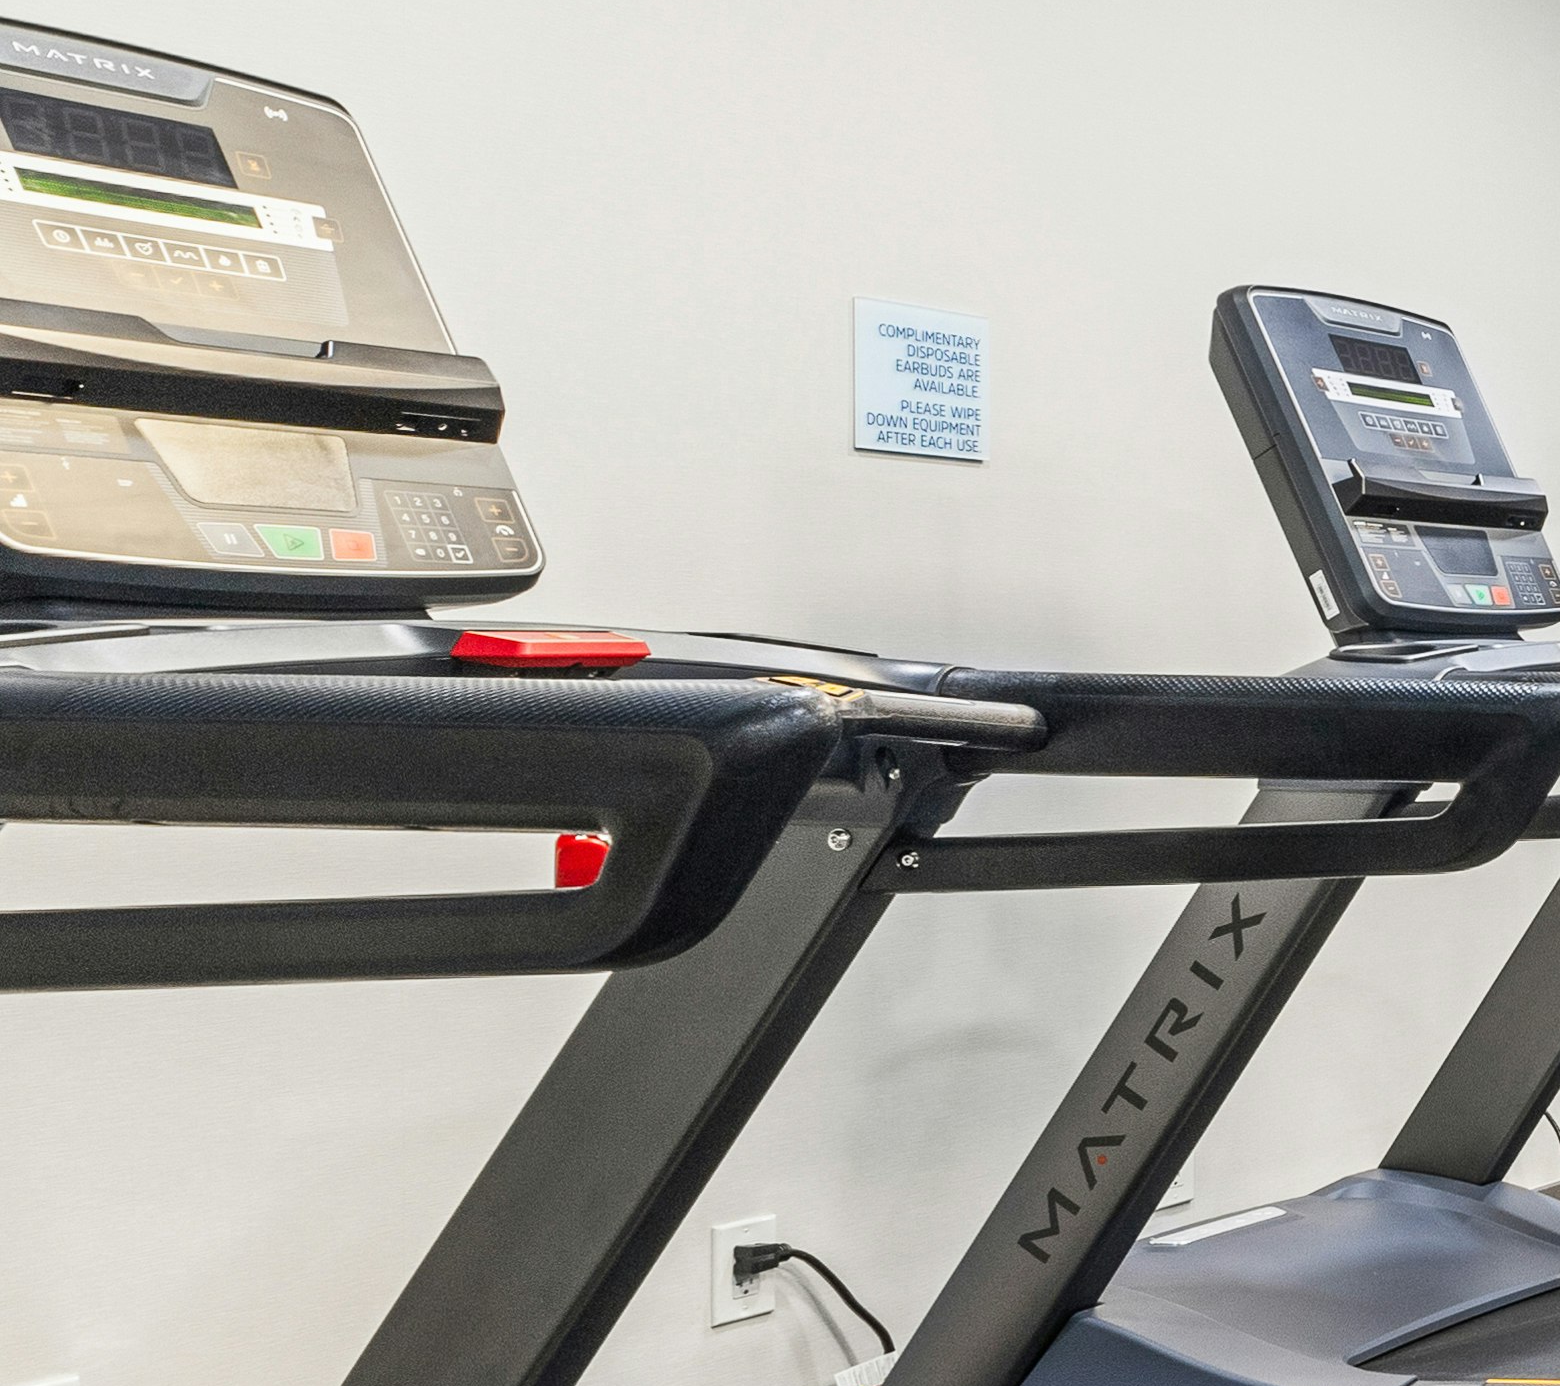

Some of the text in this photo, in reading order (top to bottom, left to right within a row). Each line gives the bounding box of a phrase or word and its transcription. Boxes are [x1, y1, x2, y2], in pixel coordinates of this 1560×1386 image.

[12, 41, 155, 80] MATRIX
[1330, 306, 1383, 322] MATRIX
[878, 323, 981, 350] COMPLIMENTARY
[907, 344, 981, 367] DISPOSABLE
[896, 358, 981, 383] EARBUDS ARE
[901, 399, 981, 422] PLEASE WIPE
[866, 412, 981, 437] DOWN EQUIPMENT
[877, 430, 982, 453] AFTER EACH USE.
[1017, 892, 1267, 1264] MATRIX
